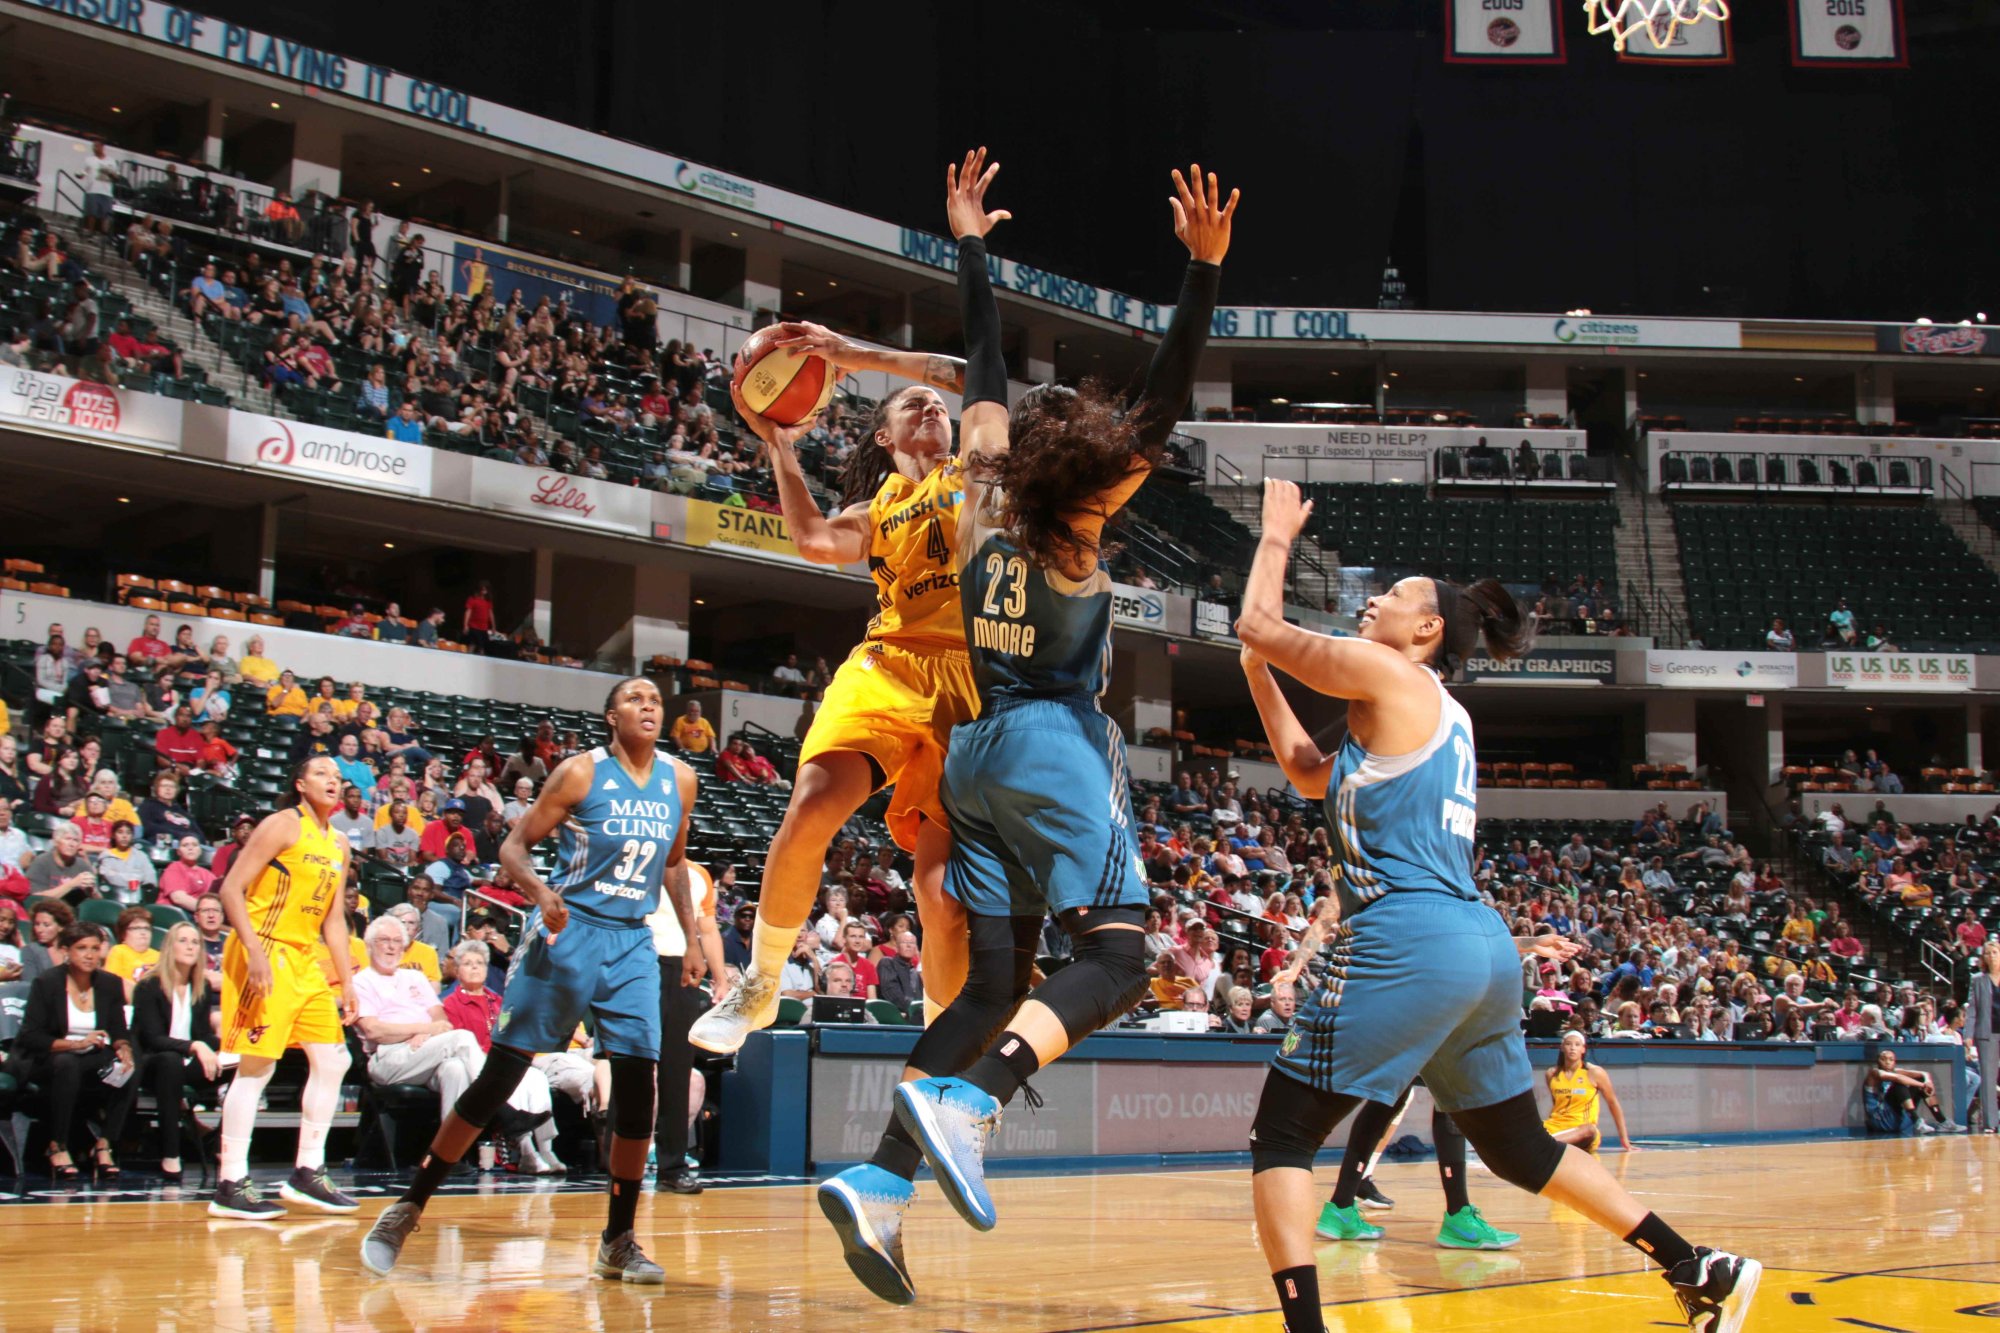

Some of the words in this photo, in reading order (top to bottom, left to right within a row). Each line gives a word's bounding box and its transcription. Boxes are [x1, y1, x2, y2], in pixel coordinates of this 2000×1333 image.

[1826, 0, 1865, 15] 2015
[165, 7, 204, 48] OF
[220, 23, 346, 89] PLAYING
[363, 65, 391, 102] IT
[408, 79, 487, 132] COOL.
[700, 172, 755, 198] citizens
[1015, 264, 1098, 314] SPONSOR
[1110, 293, 1132, 322] OF
[1140, 303, 1239, 337] PLNG
[1255, 311, 1277, 336] IT
[1294, 310, 1367, 339] COOL.
[1579, 321, 1639, 335] citizens
[12, 371, 62, 402] the
[1264, 444, 1289, 455] Text
[1323, 447, 1365, 458] (space)
[1369, 449, 1394, 459] your
[1328, 432, 1371, 445] NEED
[1376, 434, 1427, 446] HELP?
[302, 441, 406, 476] ambrose
[530, 474, 597, 518] Lilly
[717, 508, 797, 543] STANL
[880, 499, 934, 541] FINISH
[938, 490, 966, 510] LIN
[927, 515, 949, 567] 4
[904, 572, 960, 601] verizo
[983, 552, 1028, 619] 23
[16, 602, 26, 624] 5
[1466, 658, 1523, 672] SPORT
[1526, 659, 1613, 674] GRAPHICS
[1666, 662, 1718, 676] Genesys
[609, 800, 670, 819] MAYO
[603, 818, 672, 840] CLINIC
[614, 839, 657, 884] 32
[594, 880, 647, 900] verizon
[1108, 1093, 1172, 1120] AUTO
[1180, 1092, 1255, 1119] LOANS
[1004, 1124, 1058, 1150] Union
